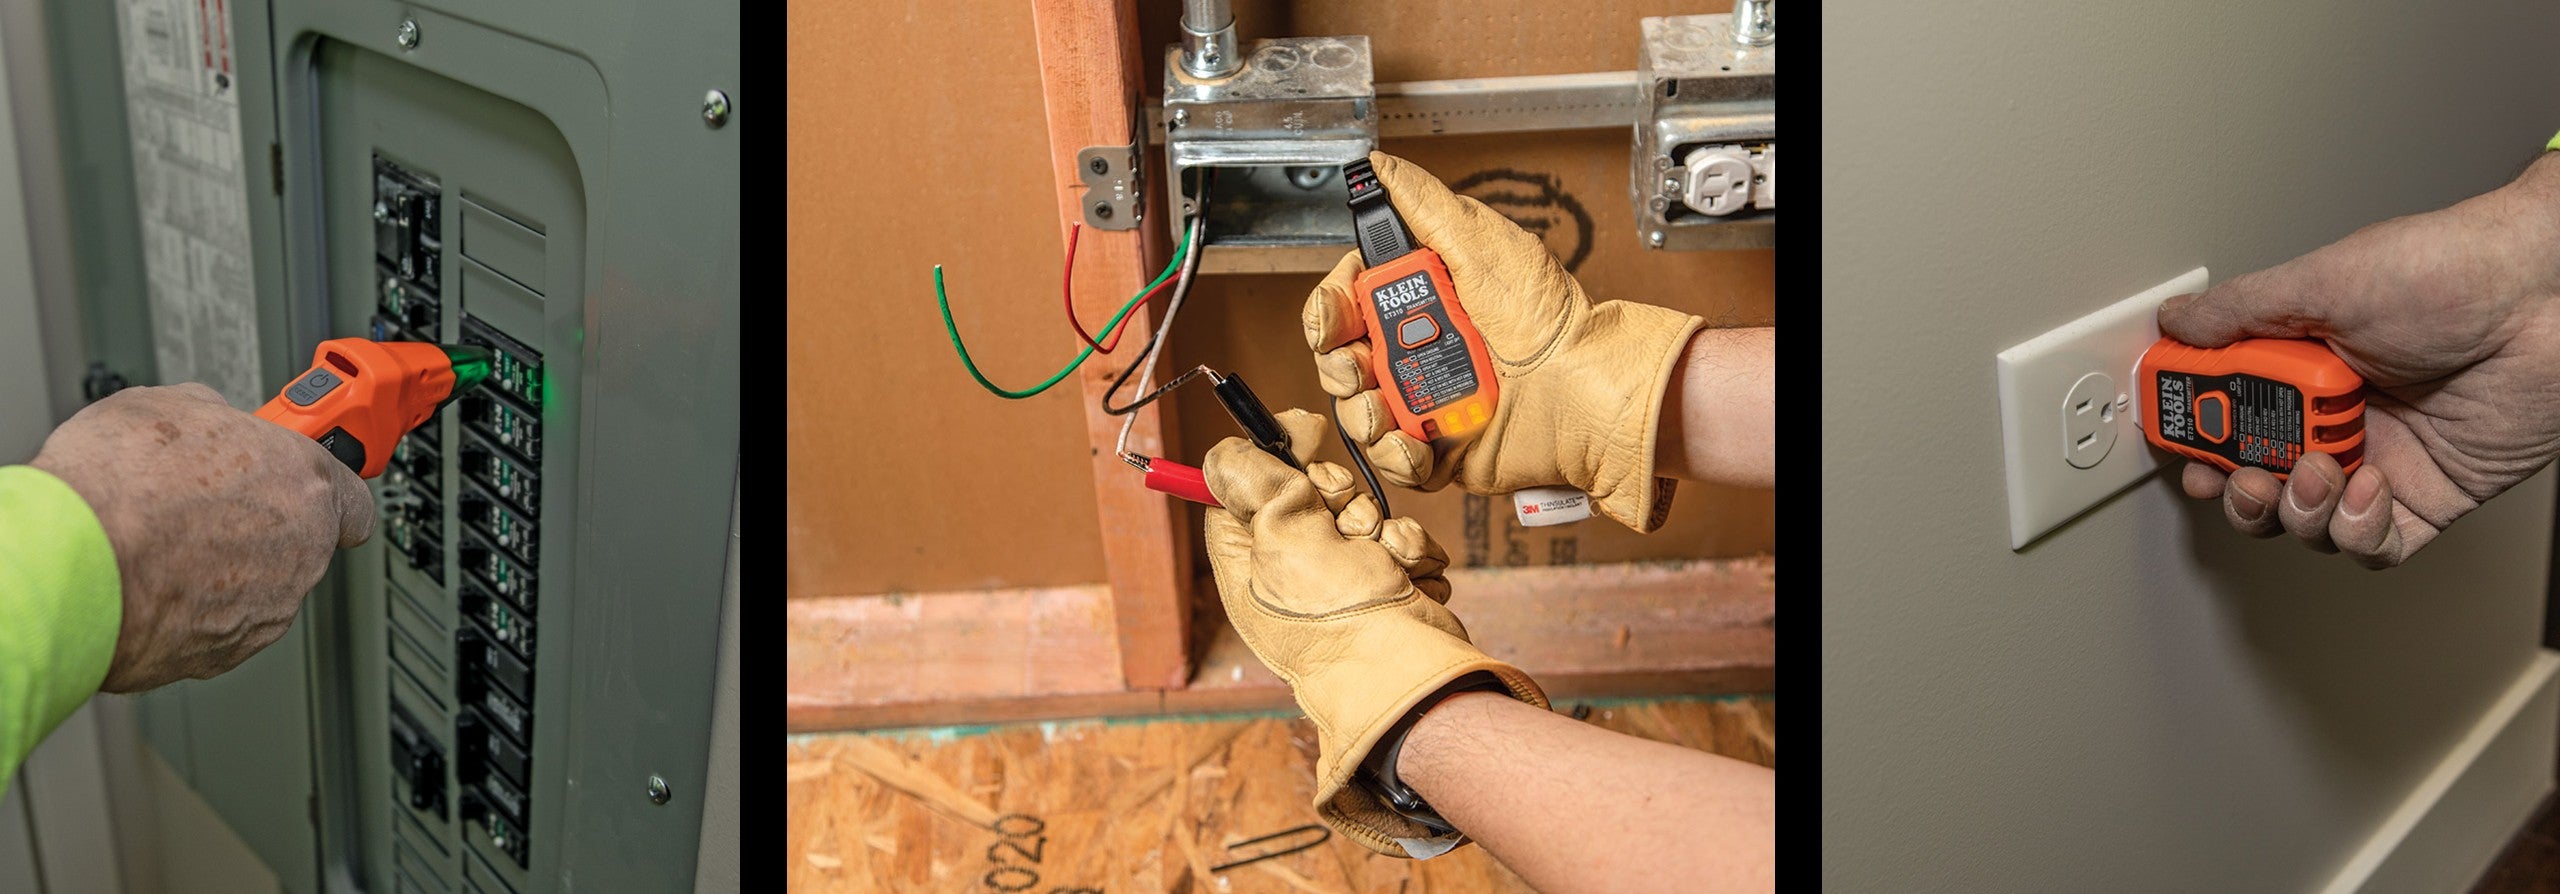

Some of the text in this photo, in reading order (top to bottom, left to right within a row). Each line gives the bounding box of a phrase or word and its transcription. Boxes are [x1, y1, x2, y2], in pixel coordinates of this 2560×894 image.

[1375, 274, 1426, 302] KLEIN
[1379, 284, 1429, 311] TOOLS
[1383, 307, 1404, 319] ET310
[2161, 377, 2174, 438] KLEIN
[2172, 380, 2185, 438] TOOLS
[1522, 504, 1540, 514] 3M
